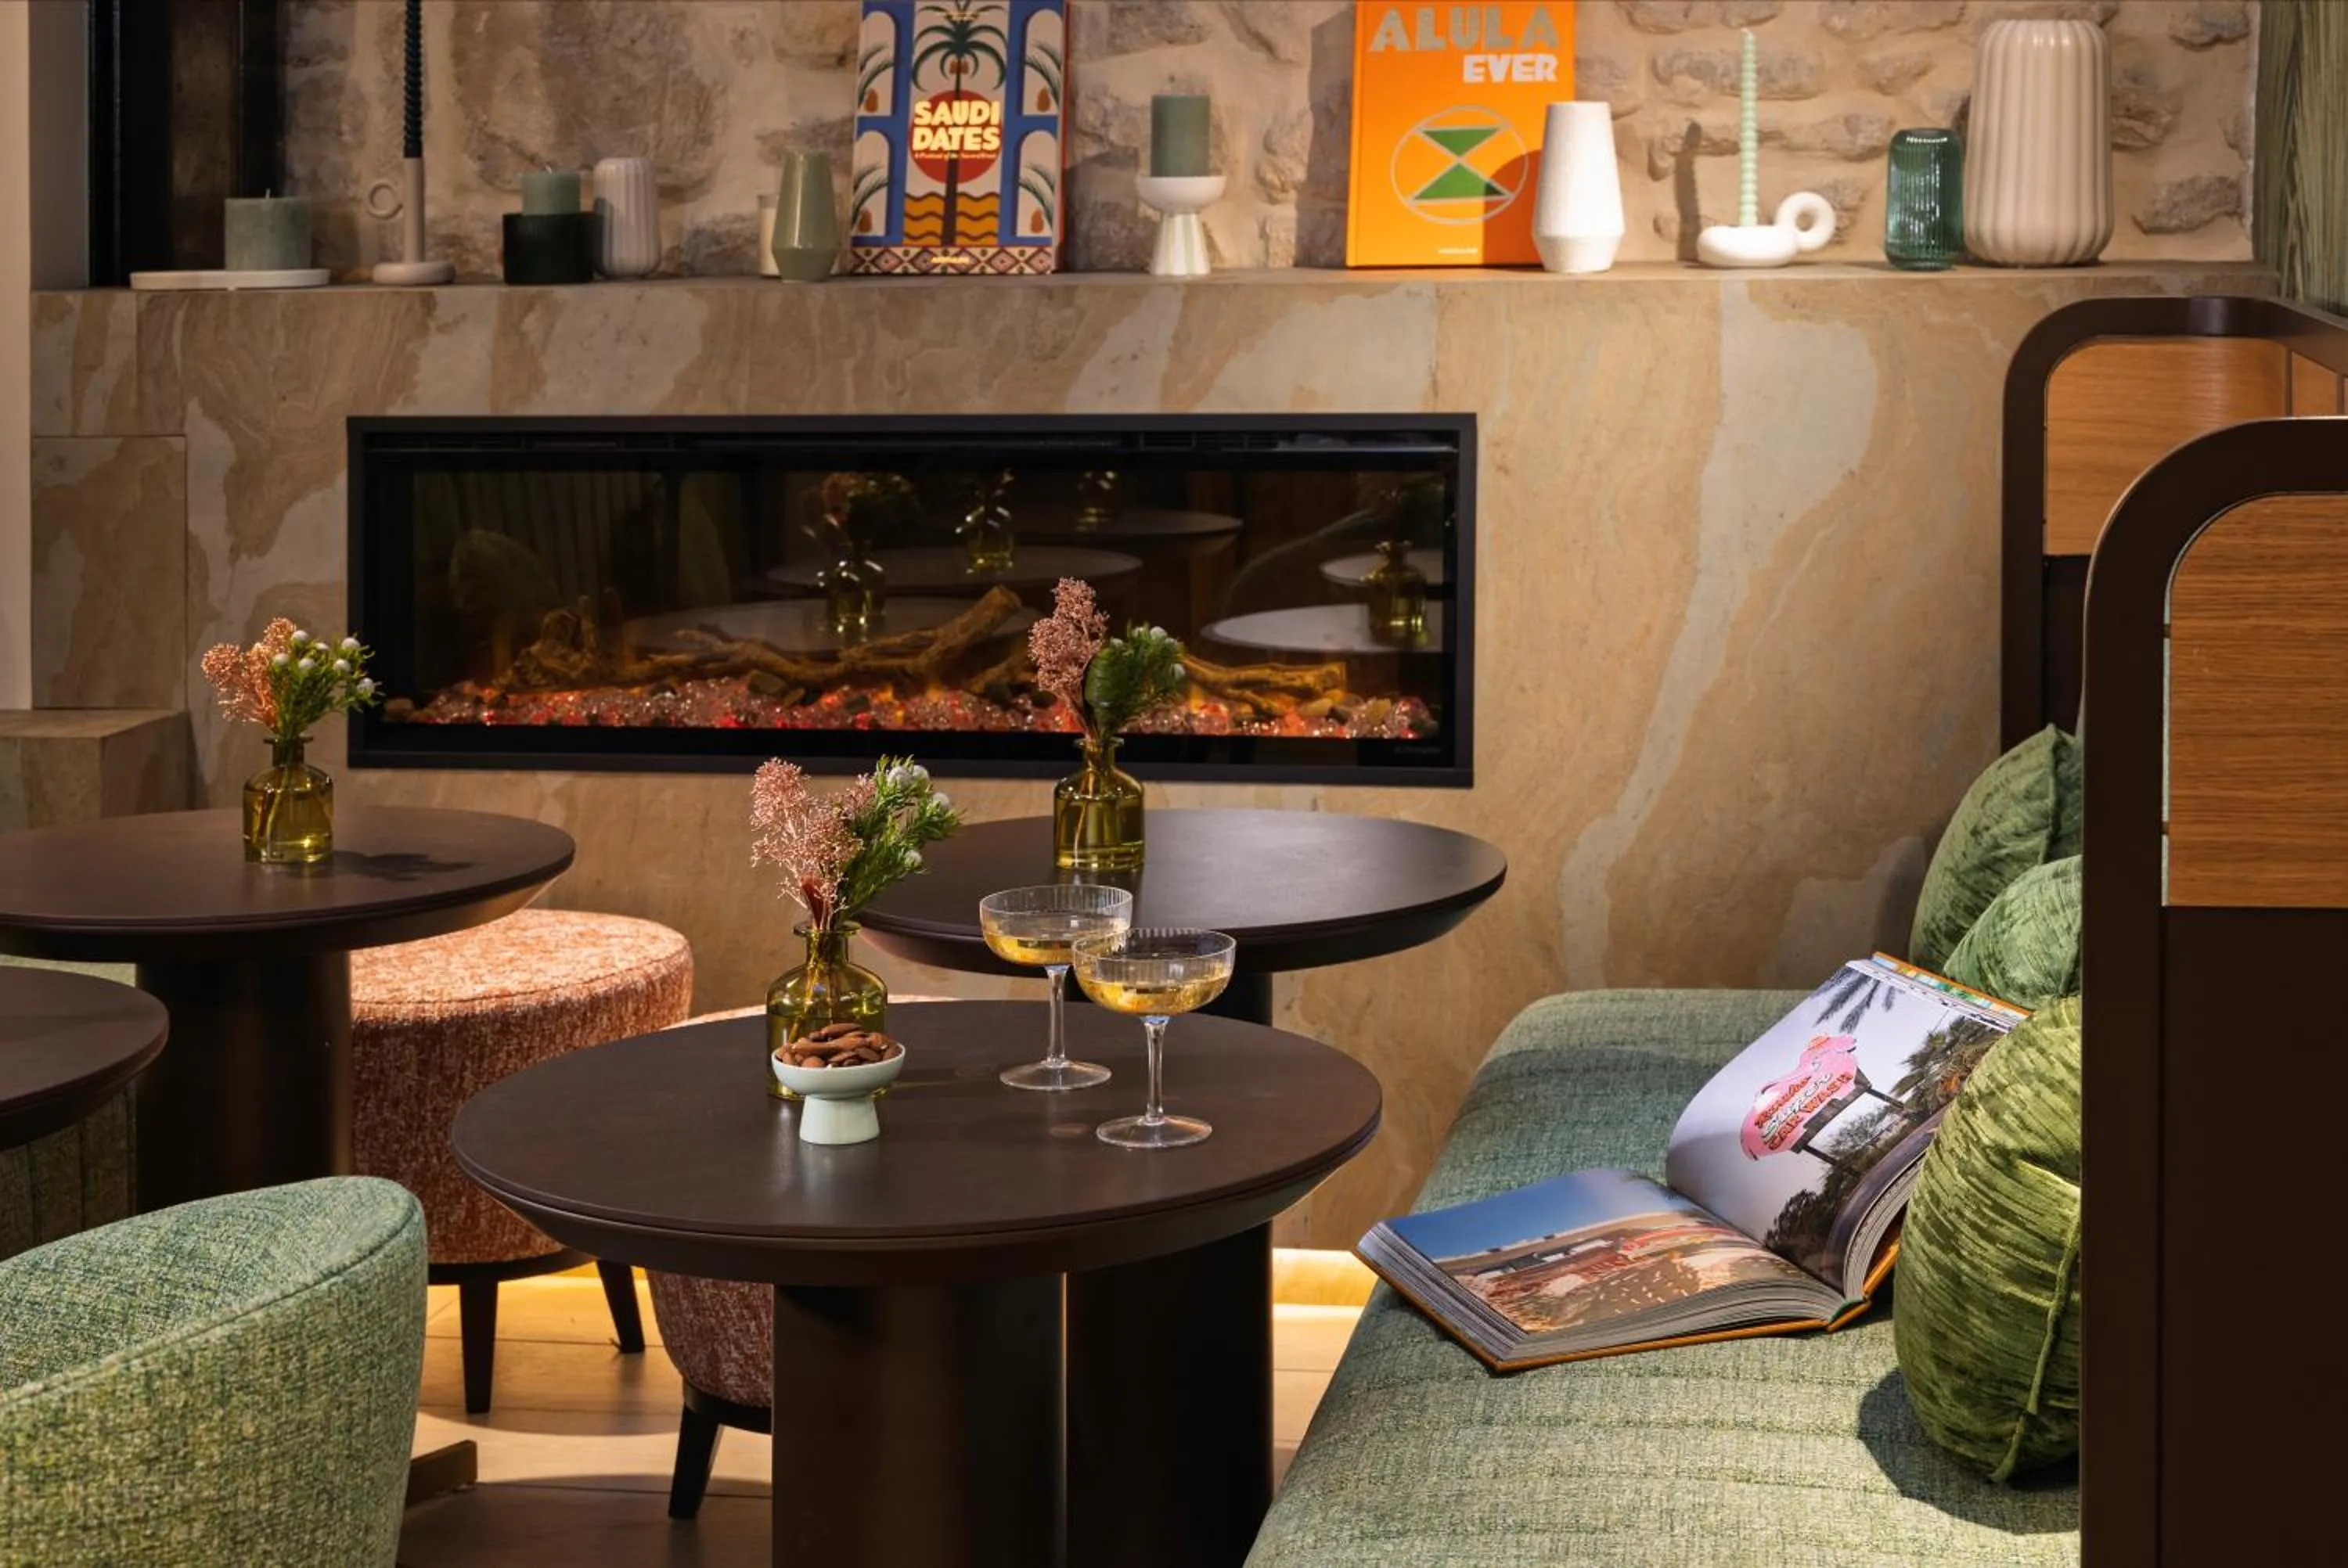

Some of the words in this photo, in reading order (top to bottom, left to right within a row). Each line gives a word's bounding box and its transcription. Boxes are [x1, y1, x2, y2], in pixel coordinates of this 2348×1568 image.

[1370, 5, 1559, 52] ALULA
[1463, 54, 1558, 83] EVER
[914, 100, 1000, 125] SAUDI
[913, 126, 1001, 151] DATES
